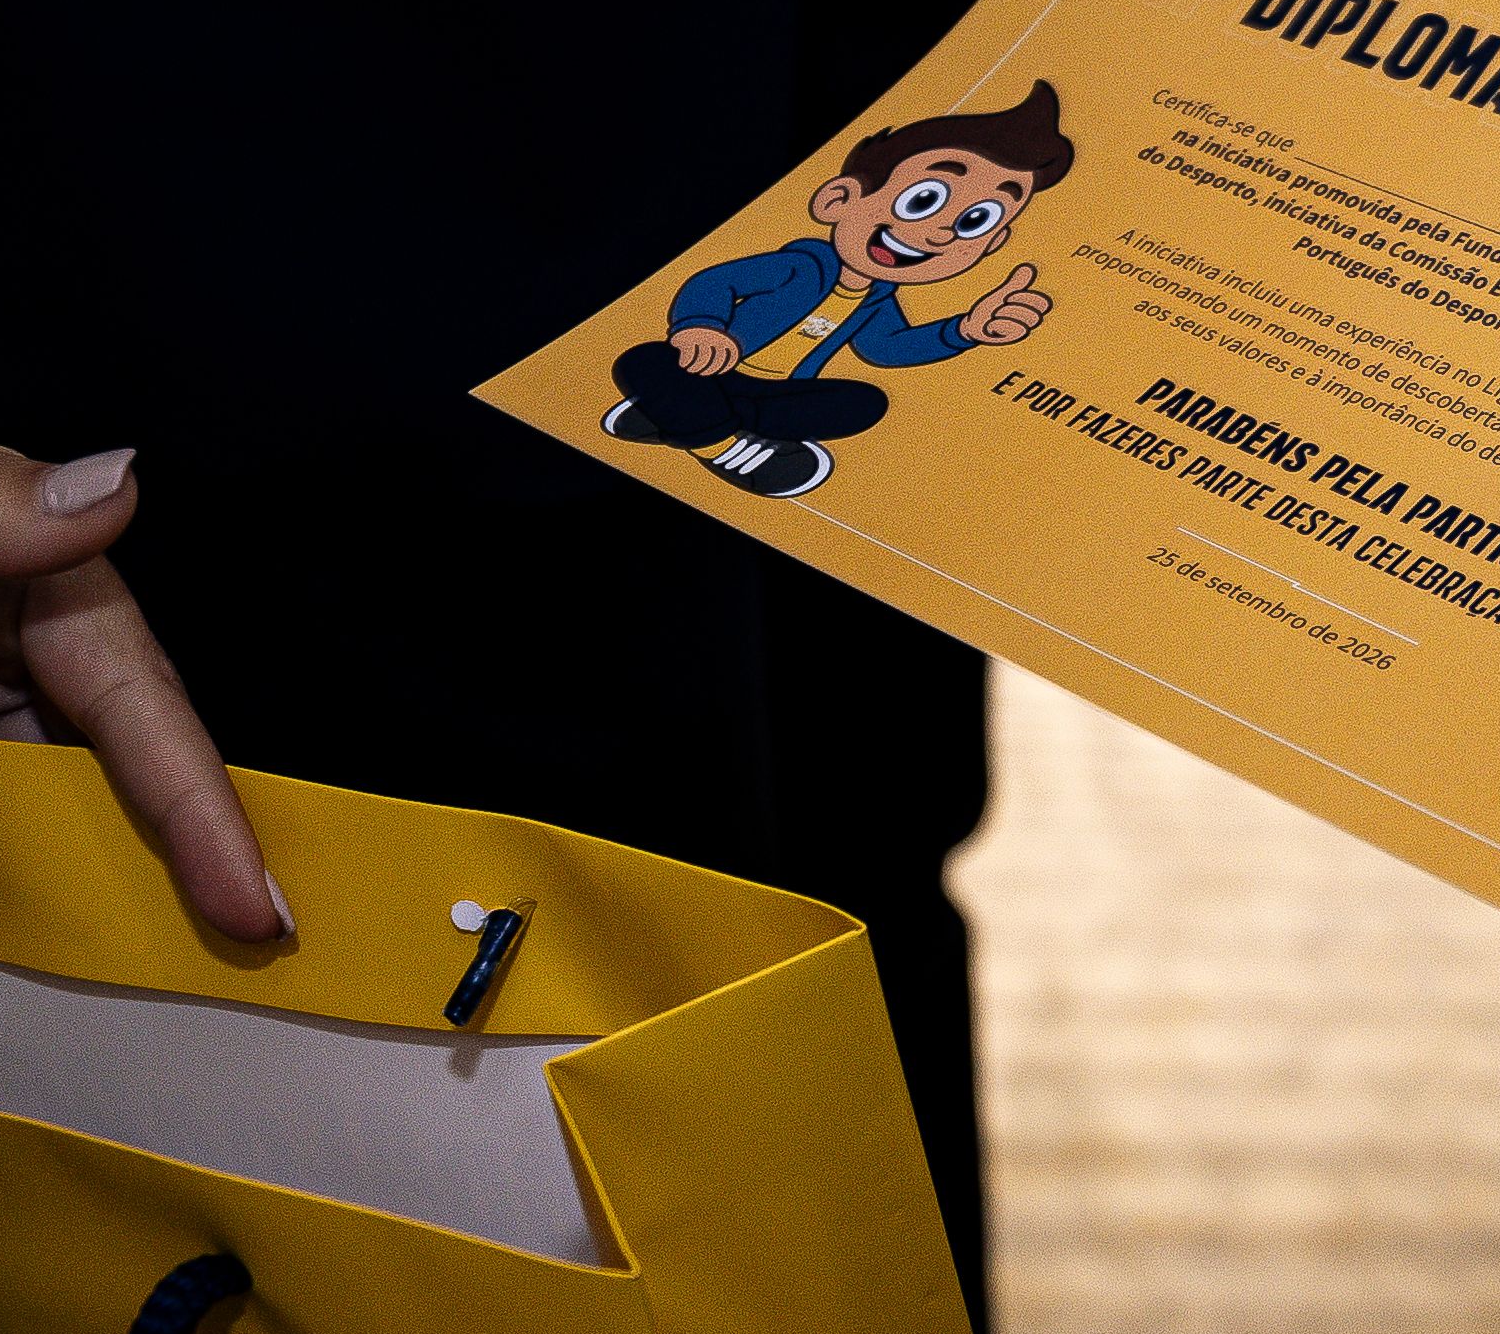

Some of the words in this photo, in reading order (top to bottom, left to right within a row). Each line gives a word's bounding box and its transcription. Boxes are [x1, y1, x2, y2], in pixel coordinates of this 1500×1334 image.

[1151, 88, 1257, 138] Certifica-se
[1255, 130, 1295, 153] que
[1172, 130, 1200, 148] na
[1199, 136, 1292, 183] iniciativa
[1288, 175, 1404, 225] promovida
[1399, 217, 1451, 243] pela
[1137, 146, 1166, 165] do
[1165, 155, 1259, 206] Desporto,
[1262, 191, 1358, 240] iniciativa
[1358, 230, 1387, 251] da
[1388, 241, 1489, 290] Comissão
[1292, 236, 1401, 289] Português
[1400, 279, 1431, 300] do
[1071, 244, 1229, 314] proporcionando
[1227, 308, 1263, 329] um
[1262, 322, 1362, 371] momento
[1361, 362, 1391, 383] de
[1117, 229, 1136, 245] A
[1134, 237, 1222, 281] iniciativa
[1220, 269, 1289, 308] incluiu
[1288, 301, 1336, 328] uma
[1335, 320, 1452, 376] experiência
[1451, 368, 1482, 388] no
[1133, 300, 1172, 322] aos
[1169, 315, 1218, 342] seus
[1218, 335, 1291, 373] valores
[1290, 366, 1307, 380] e
[1305, 368, 1324, 387] à
[1321, 379, 1448, 440] importância
[1446, 431, 1478, 453] do
[991, 370, 1026, 396] E
[1012, 379, 1077, 421] POR
[1066, 404, 1189, 471] FAZERES
[1177, 455, 1276, 511] PARTE
[1263, 494, 1361, 552] DESTA
[1135, 377, 1321, 473] PARABÉNS
[1308, 453, 1410, 516] PELA
[1146, 547, 1180, 568] 25
[1175, 562, 1207, 582] de
[1204, 575, 1308, 630] setembro
[1307, 623, 1339, 645] de
[1336, 636, 1397, 671] 2026
